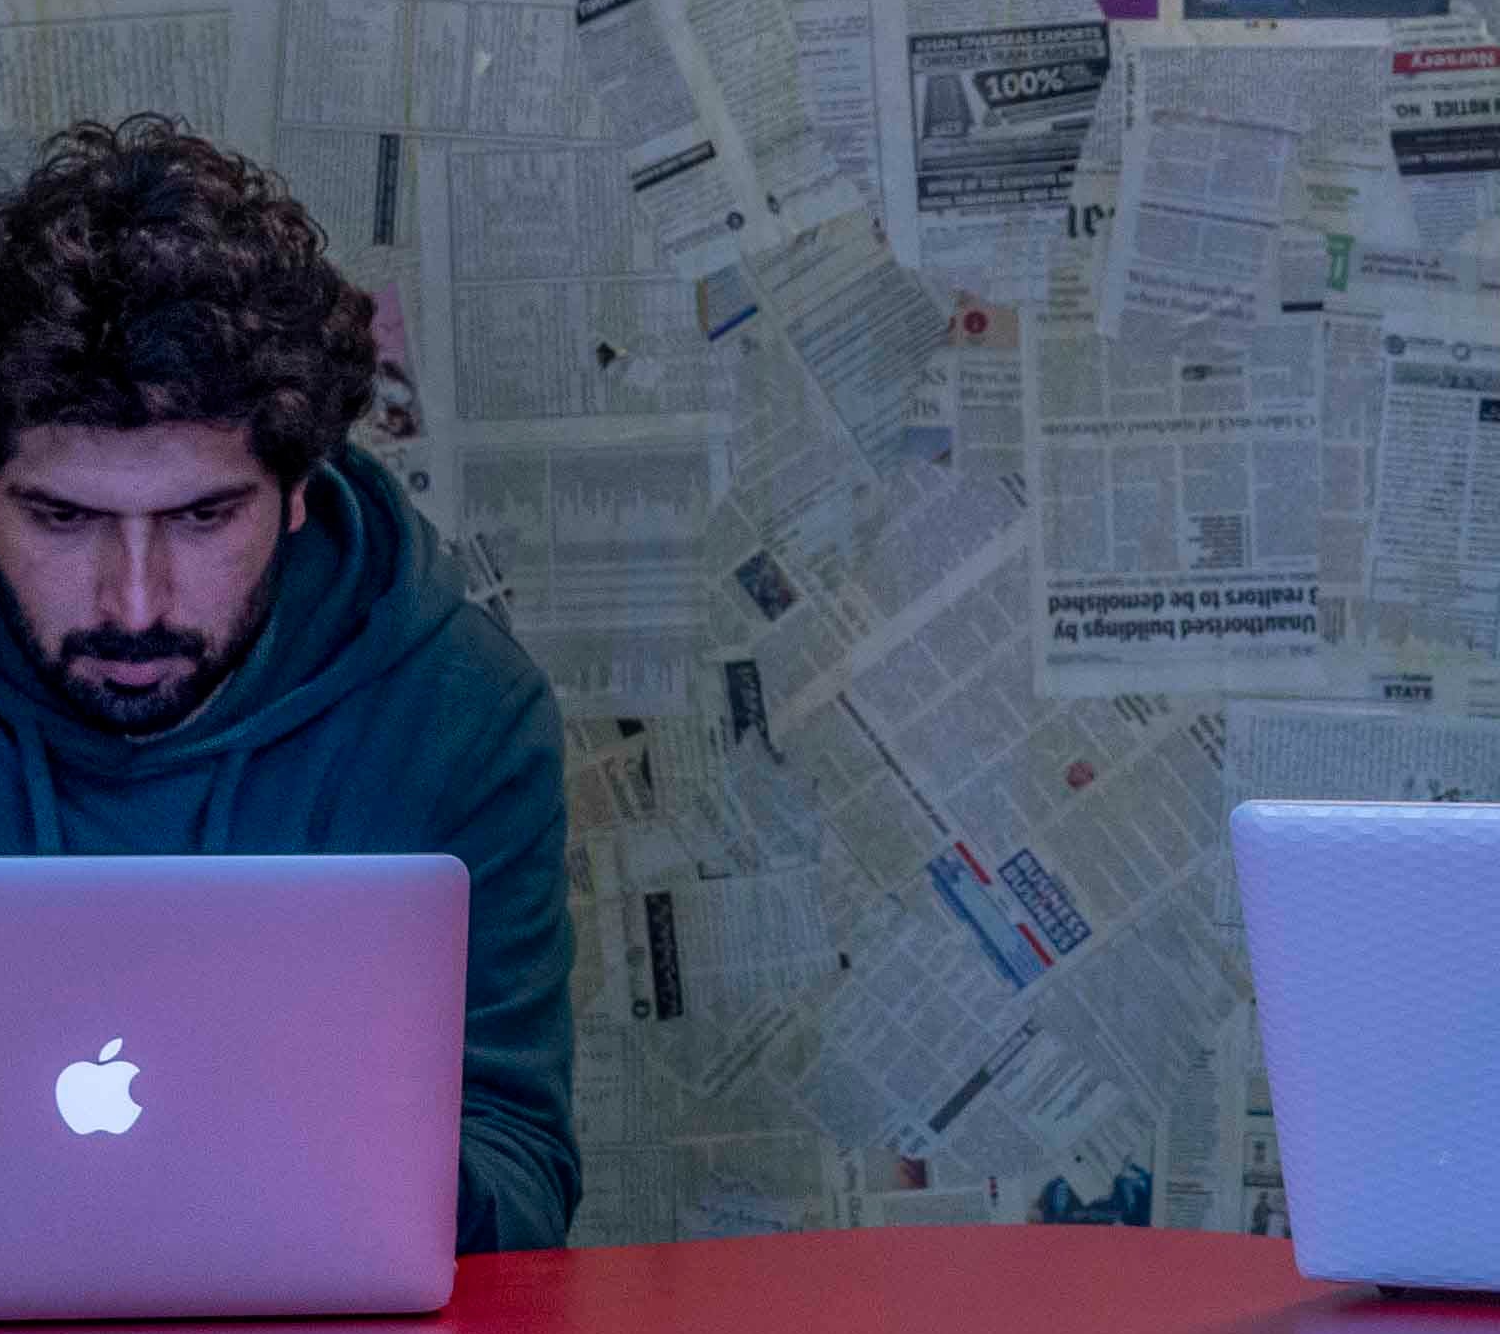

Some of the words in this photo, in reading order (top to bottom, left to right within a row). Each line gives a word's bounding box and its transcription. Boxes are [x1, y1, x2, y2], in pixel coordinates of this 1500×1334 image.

[1410, 46, 1495, 70] Nursery
[983, 67, 1063, 99] 100%
[1046, 590, 1162, 615] demolished
[1168, 589, 1196, 612] be
[1199, 588, 1220, 609] to
[1223, 585, 1302, 611] realtors
[1052, 613, 1076, 641] by
[1080, 613, 1174, 640] buildings
[1179, 610, 1316, 639] Unauthorised
[1383, 684, 1433, 701] STATE
